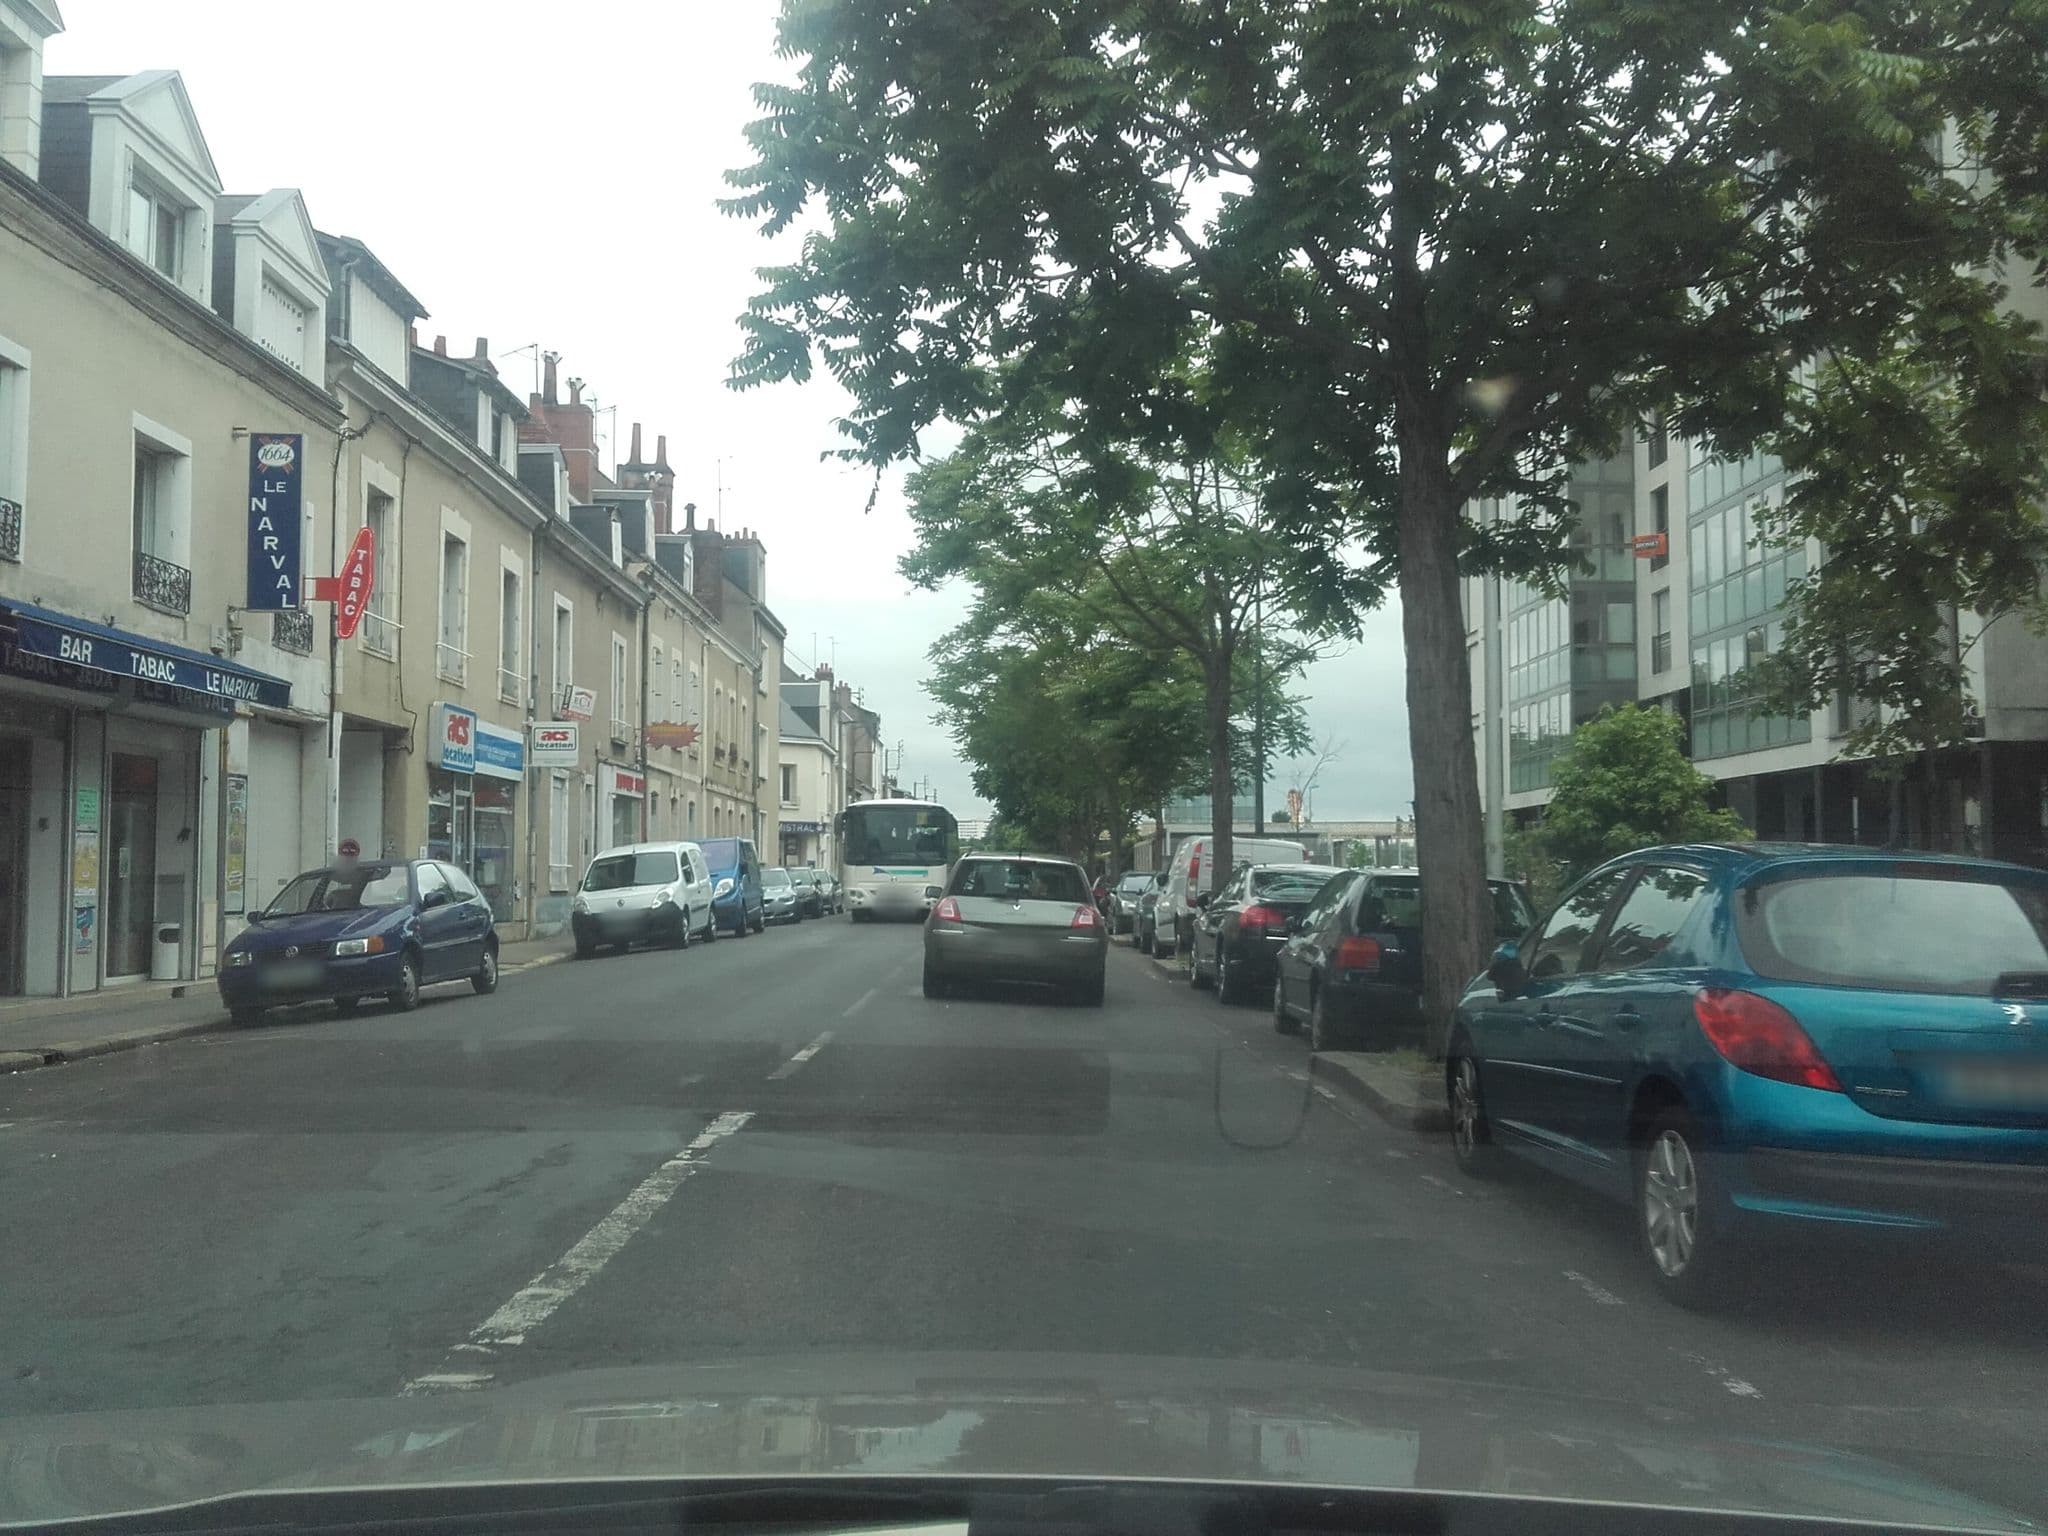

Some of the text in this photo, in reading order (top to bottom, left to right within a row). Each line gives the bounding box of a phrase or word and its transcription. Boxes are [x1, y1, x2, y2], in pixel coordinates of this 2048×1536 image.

[260, 446, 292, 461] 1664
[264, 479, 287, 493] LE
[251, 497, 296, 608] NARVAL
[344, 549, 367, 616] TABAC
[60, 634, 259, 700] BAR TABAC LE NARVAL
[443, 742, 473, 764] location
[535, 741, 574, 749] location
